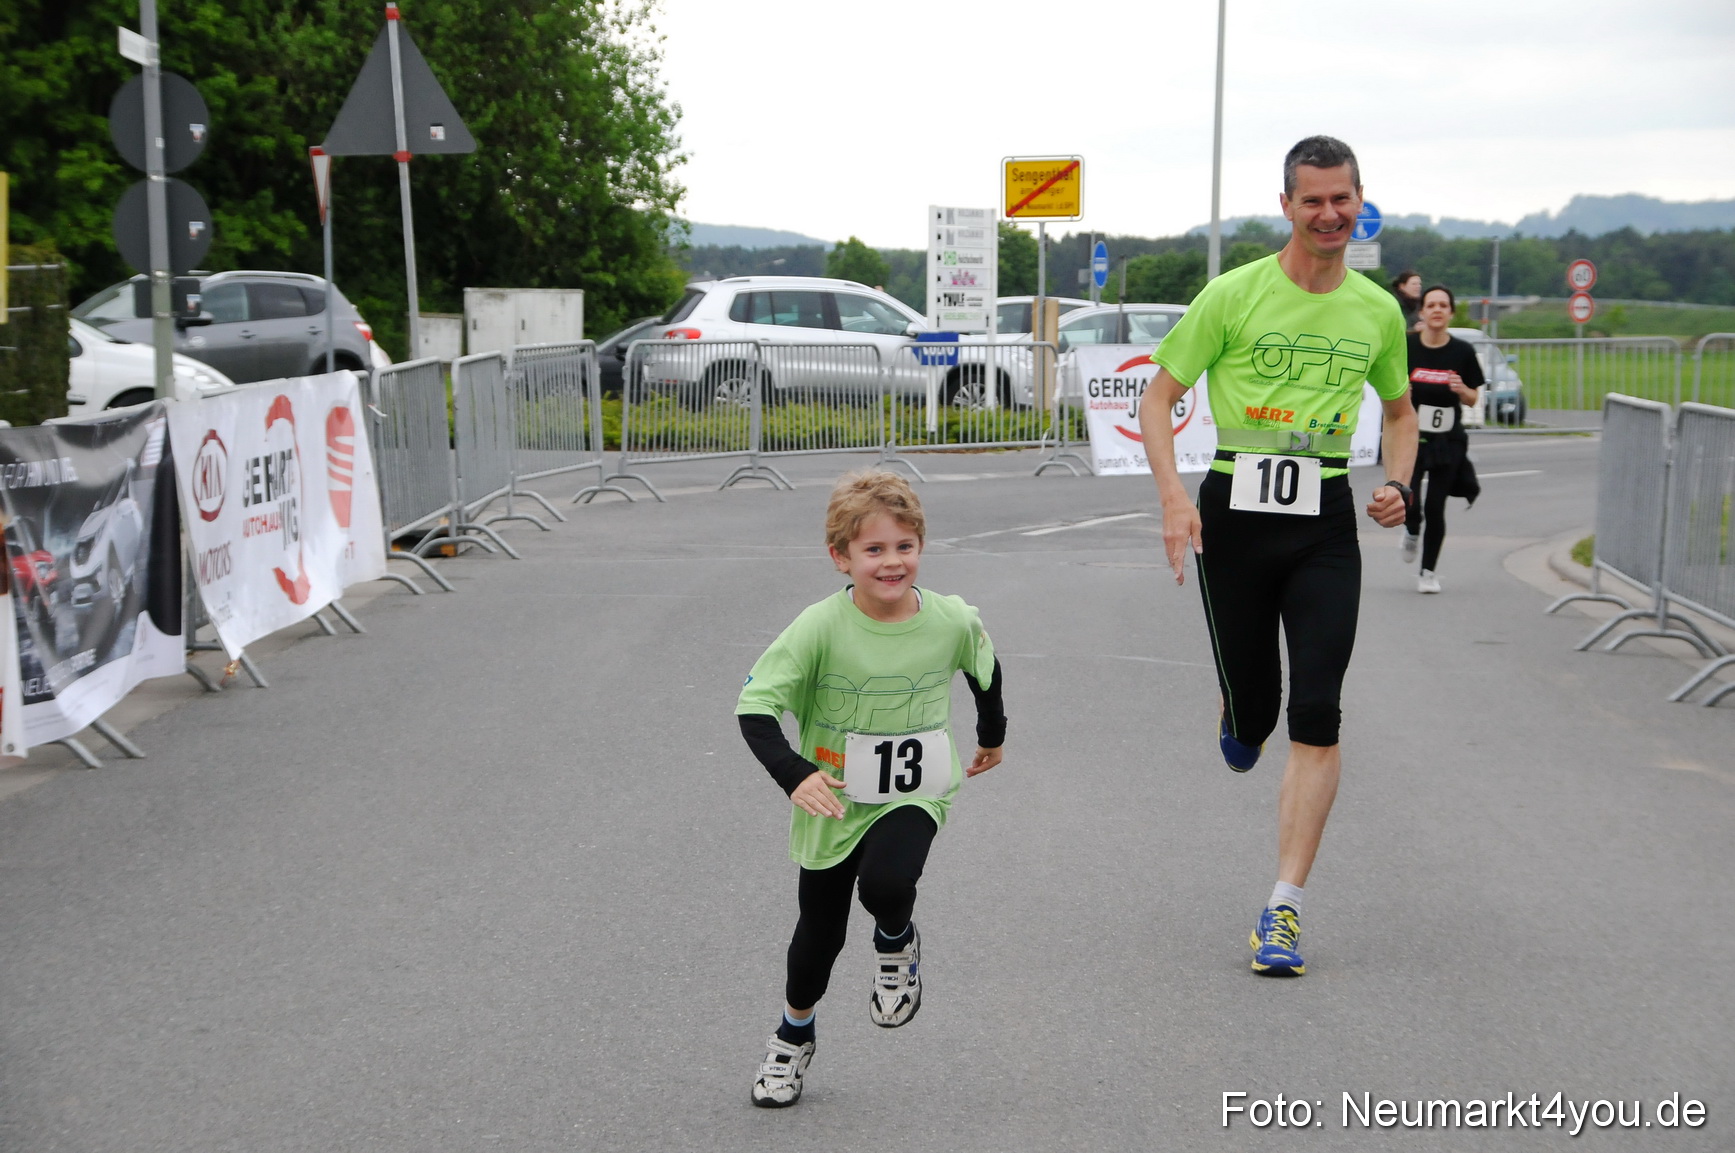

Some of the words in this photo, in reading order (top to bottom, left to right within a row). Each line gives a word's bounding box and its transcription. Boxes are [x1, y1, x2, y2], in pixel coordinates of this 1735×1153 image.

[943, 292, 965, 307] THULE
[1088, 377, 1150, 398] GERHA
[1089, 401, 1129, 411] Autohaus
[1245, 405, 1296, 424] MERZ
[1431, 408, 1443, 429] 6
[1256, 457, 1300, 506] 10
[815, 746, 846, 769] ME
[874, 738, 923, 794] 13
